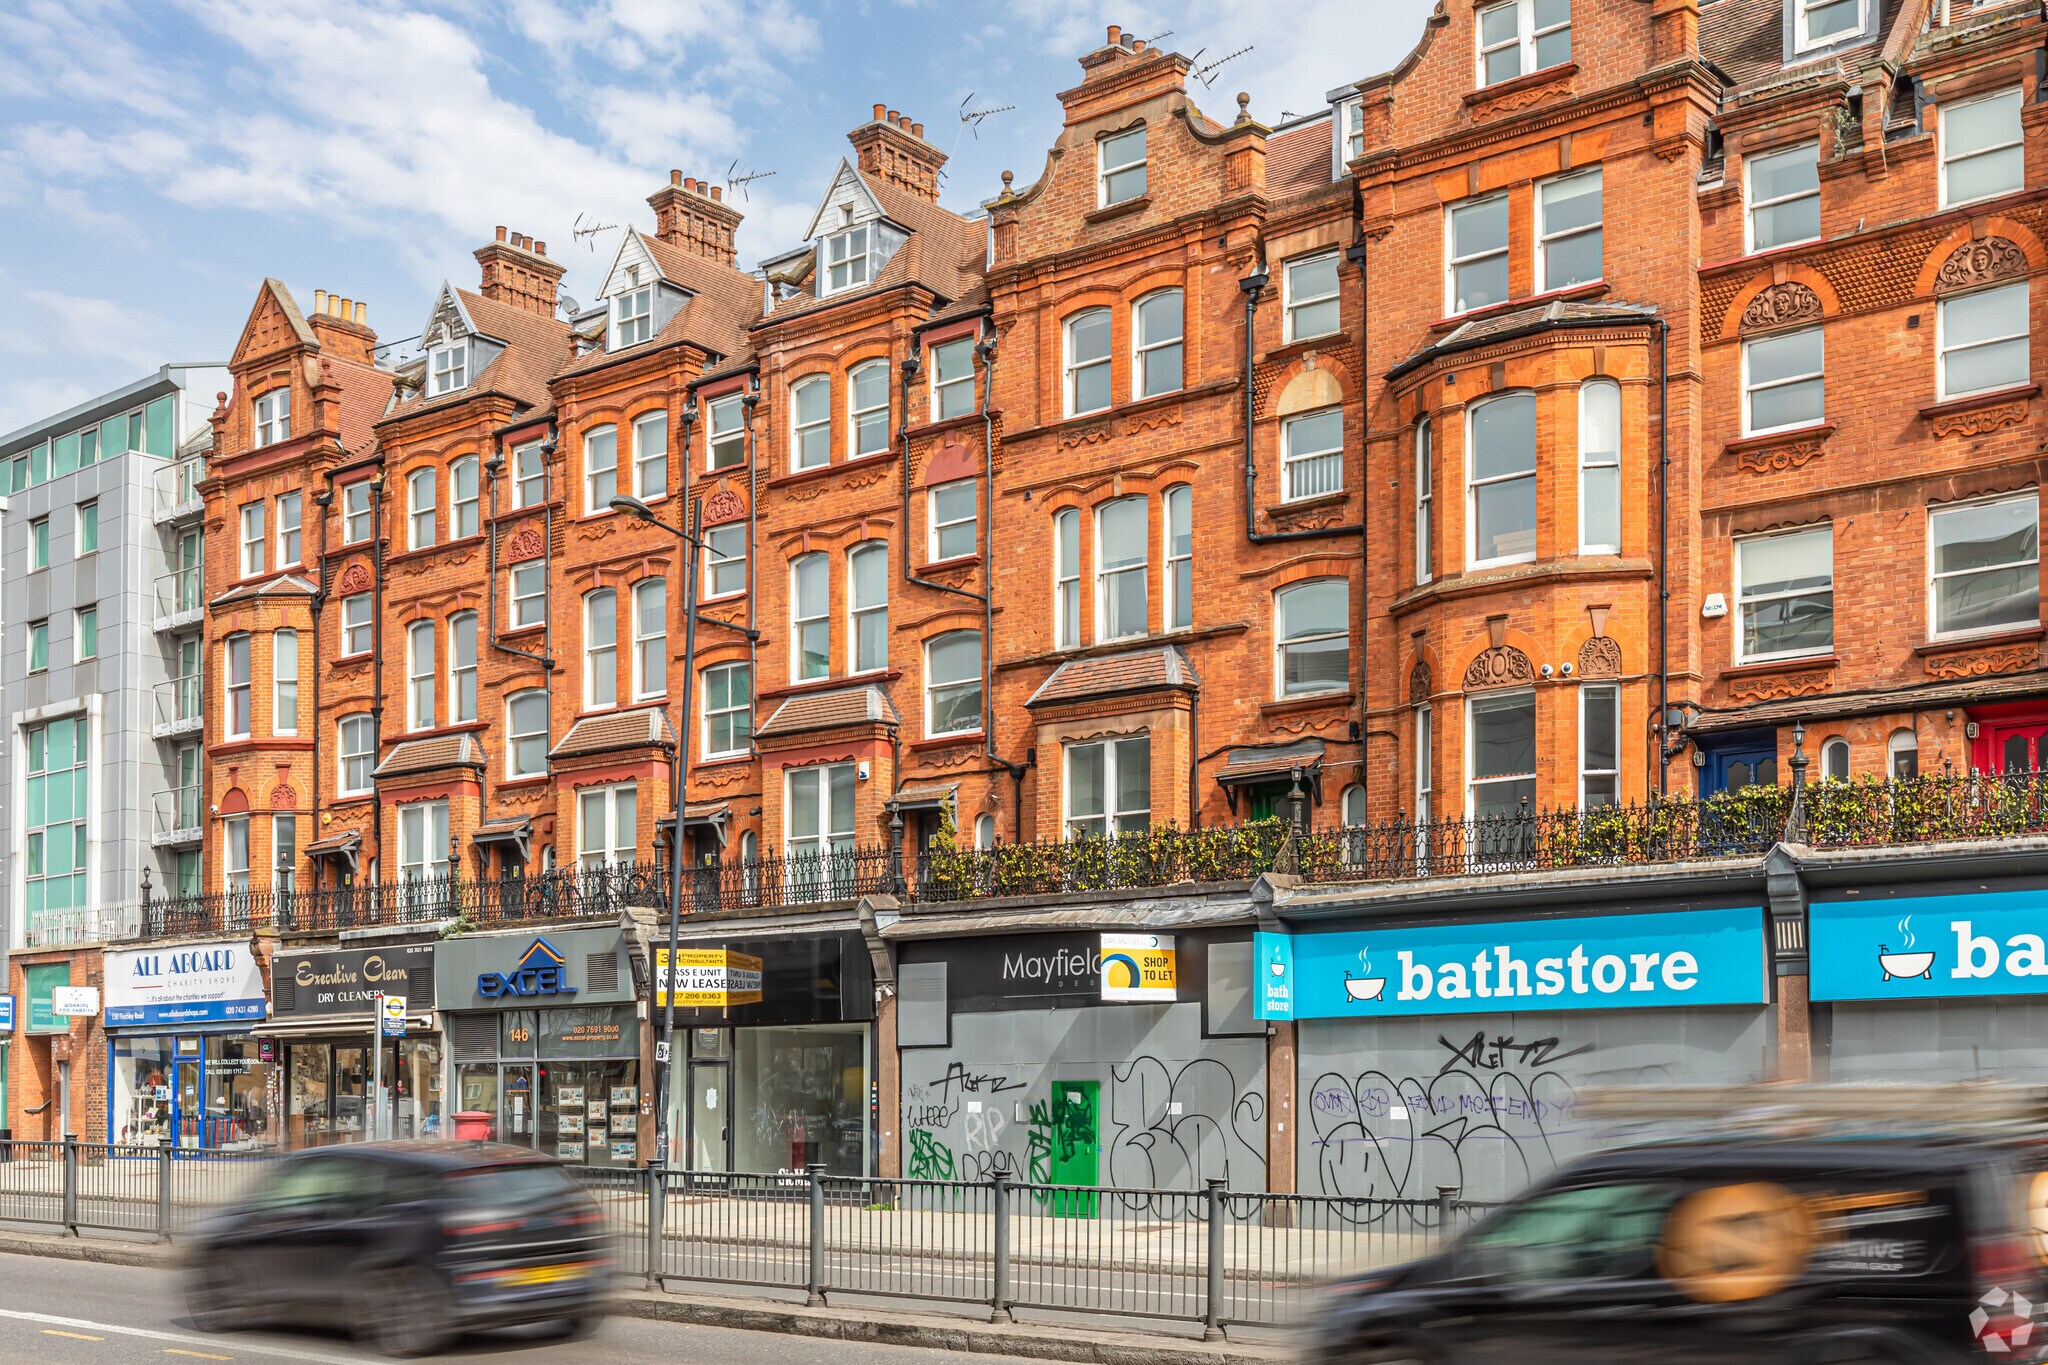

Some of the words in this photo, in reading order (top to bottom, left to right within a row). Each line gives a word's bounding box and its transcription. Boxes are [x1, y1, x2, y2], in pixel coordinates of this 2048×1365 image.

[133, 955, 163, 976] ALL
[168, 949, 236, 974] ABOARD
[1144, 957, 1169, 968] SHOP
[295, 960, 357, 987] Executive
[363, 955, 408, 982] Clean
[663, 969, 690, 977] CASS
[1144, 970, 1156, 980] TO
[1158, 970, 1173, 980] LET
[1397, 944, 1698, 1000] bathstore
[168, 979, 203, 988] CHARITY
[209, 976, 235, 985] SHOPS
[477, 968, 578, 997] EXCEL
[659, 979, 689, 988] NW
[693, 979, 726, 988] LEASE
[1267, 983, 1289, 998] bath
[318, 992, 335, 1003] DRY
[1267, 999, 1289, 1011] store
[510, 1028, 529, 1041] 146
[573, 1026, 585, 1034] 020
